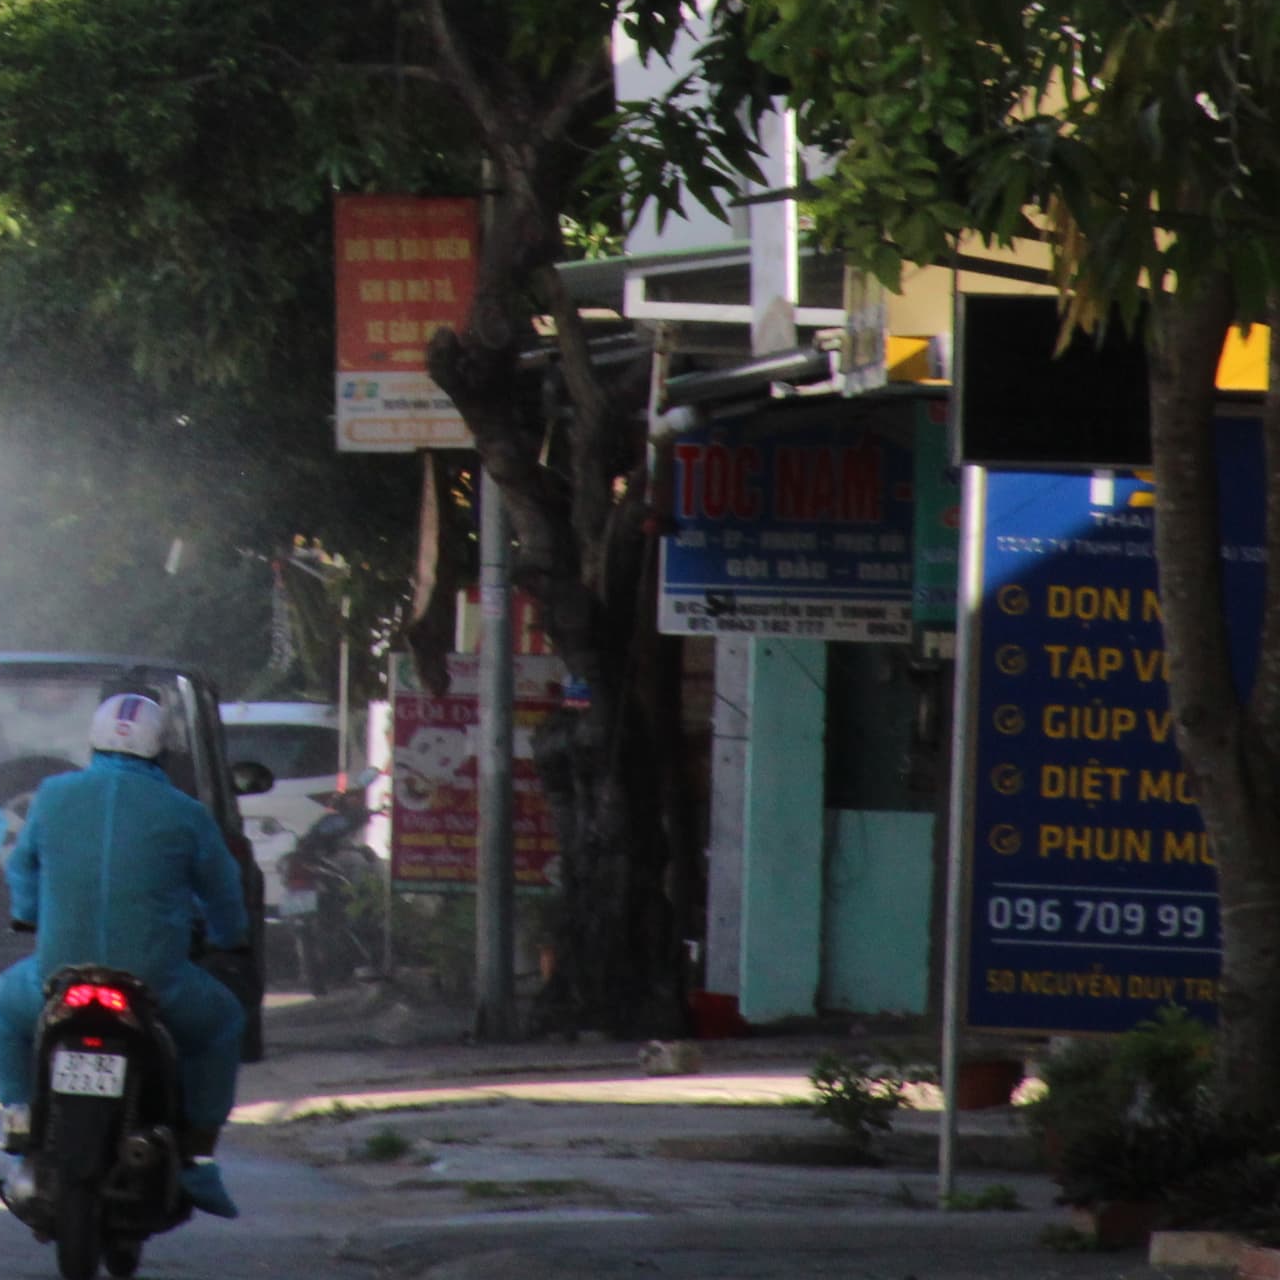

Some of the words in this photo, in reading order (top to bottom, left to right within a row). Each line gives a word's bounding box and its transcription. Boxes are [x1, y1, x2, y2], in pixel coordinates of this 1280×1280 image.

[1046, 585, 1131, 628] DỌN
[1042, 644, 1124, 688] TẠP
[1041, 698, 1137, 741] GIÚP
[1040, 758, 1129, 809] DIỆT
[1038, 823, 1152, 863] PHUN
[987, 896, 1063, 933] 096
[1072, 900, 1146, 936] 709
[1156, 903, 1206, 939] 99
